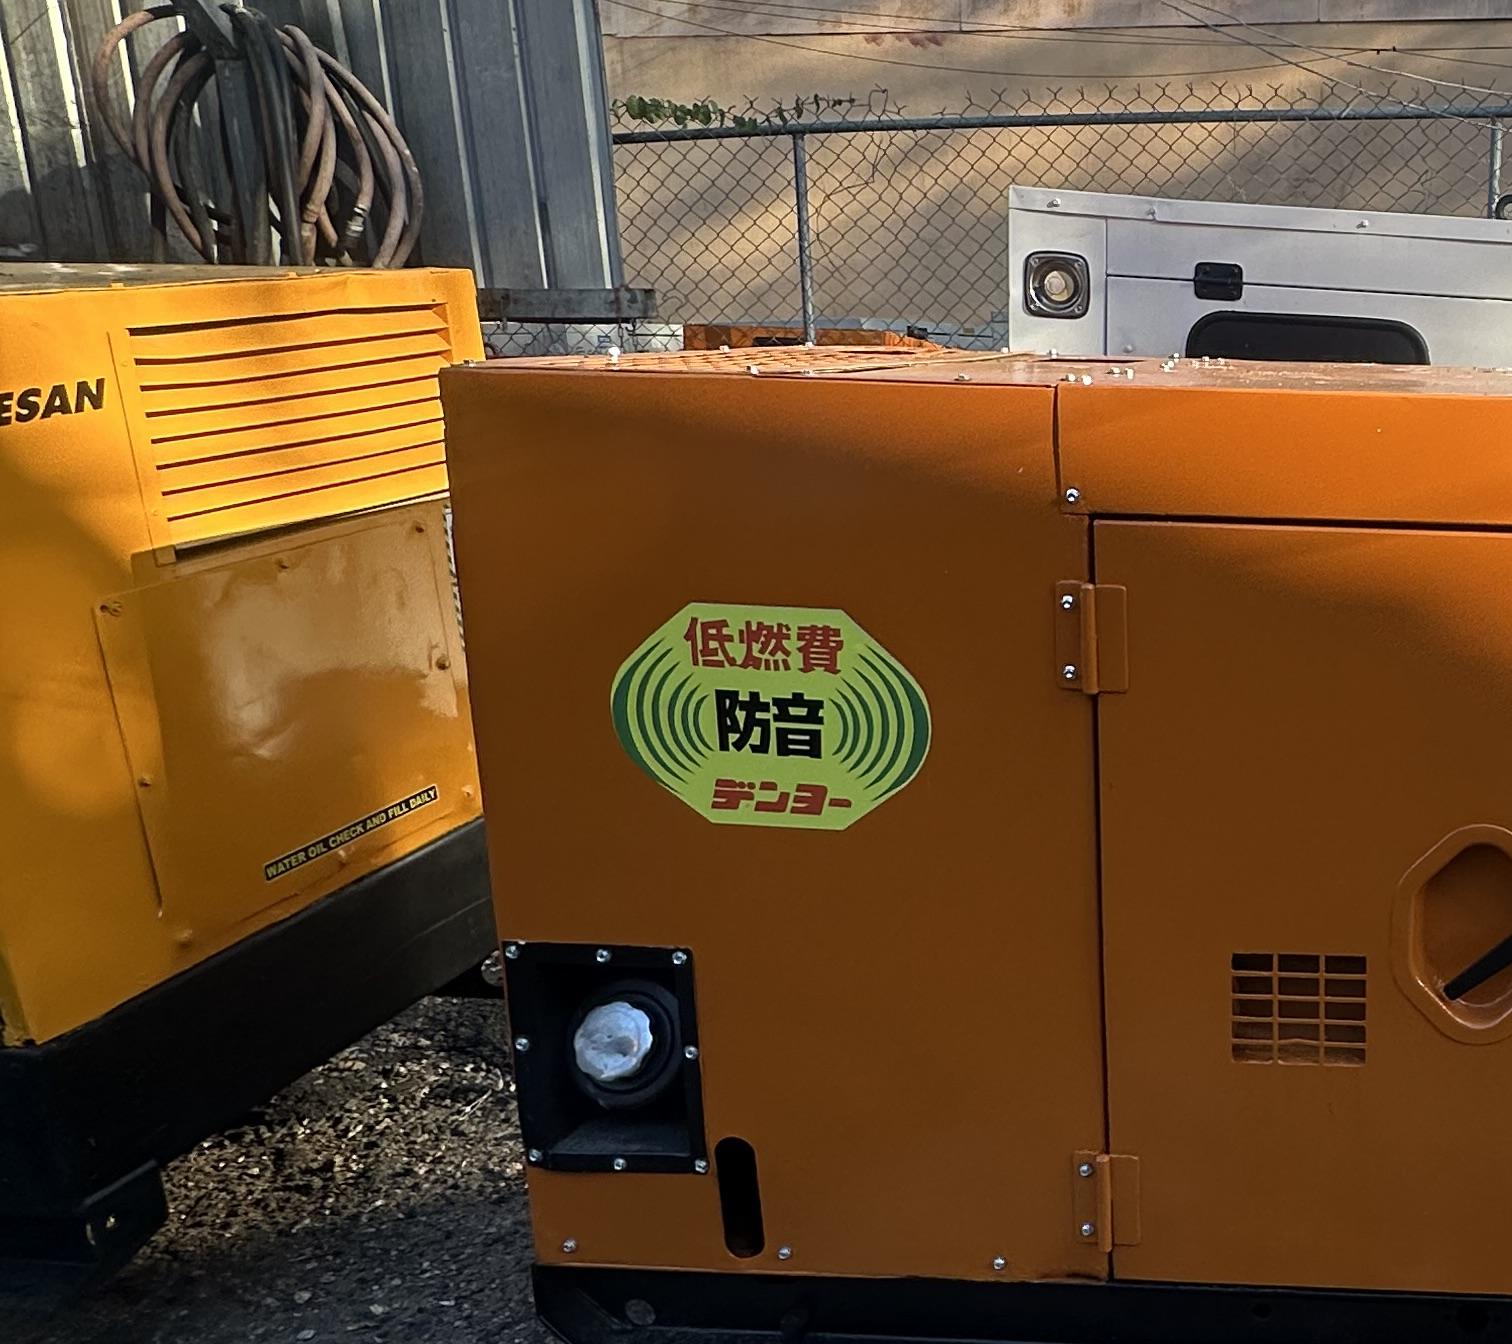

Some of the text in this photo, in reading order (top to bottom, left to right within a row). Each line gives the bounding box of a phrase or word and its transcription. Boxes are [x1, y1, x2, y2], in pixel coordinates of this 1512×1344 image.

[684, 616, 845, 676] 低燃費
[714, 687, 825, 760] 防音
[710, 778, 853, 817] デンヨー
[266, 788, 436, 879] WATER OIL CHECK AND FILL DAILY
